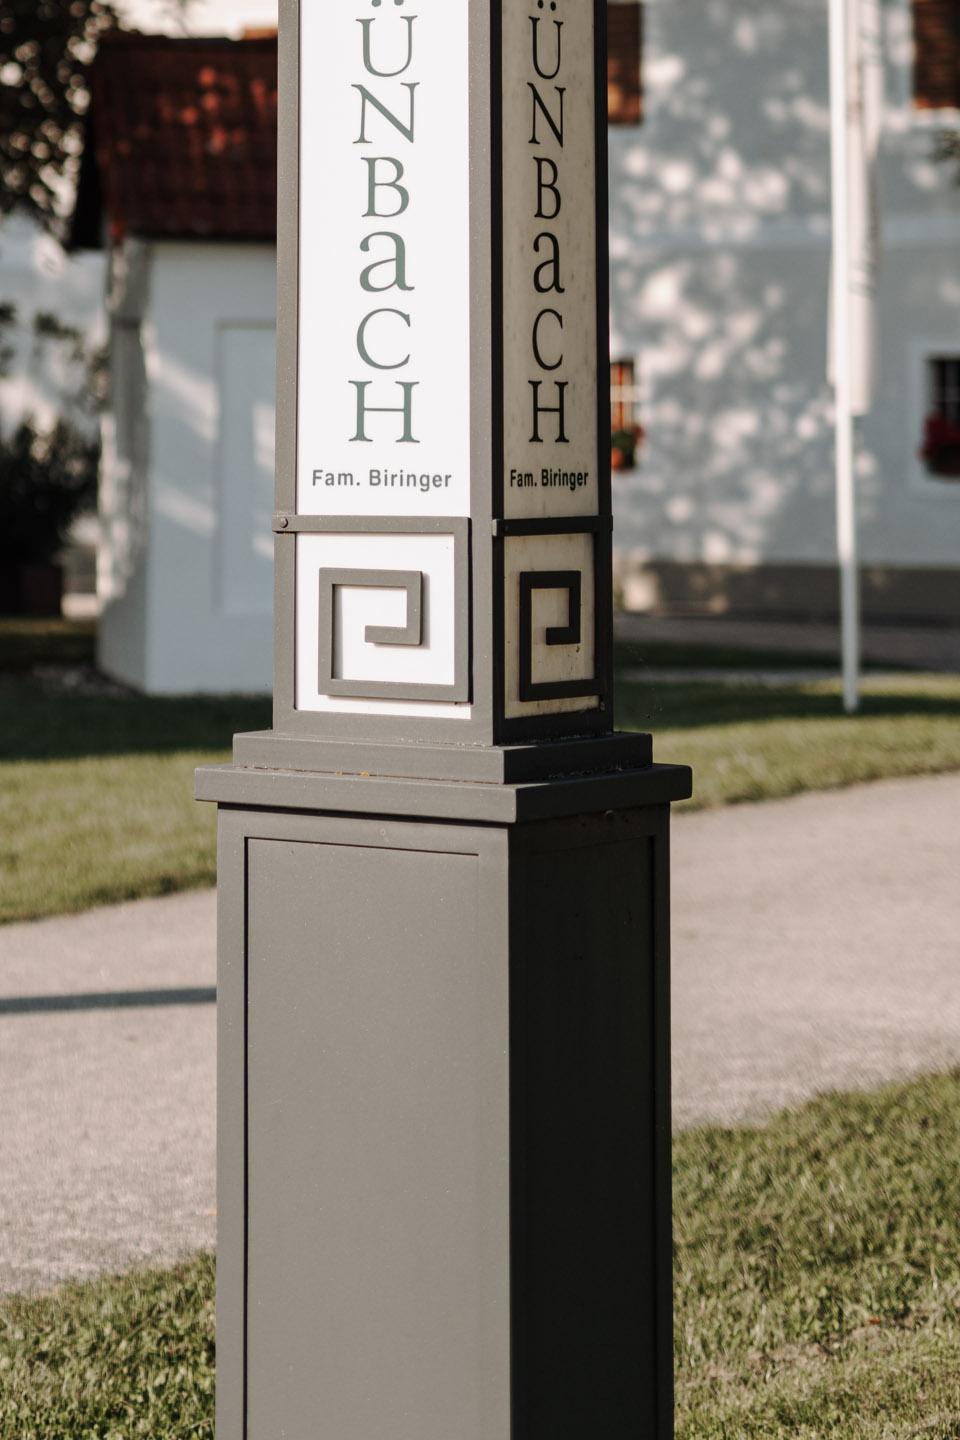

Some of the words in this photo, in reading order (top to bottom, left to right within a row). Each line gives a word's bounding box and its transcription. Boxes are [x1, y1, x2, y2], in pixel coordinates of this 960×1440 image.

[312, 469, 361, 487] Fam.
[369, 468, 452, 493] Biringer
[510, 469, 538, 488] Fam.
[541, 467, 589, 492] Biringer
